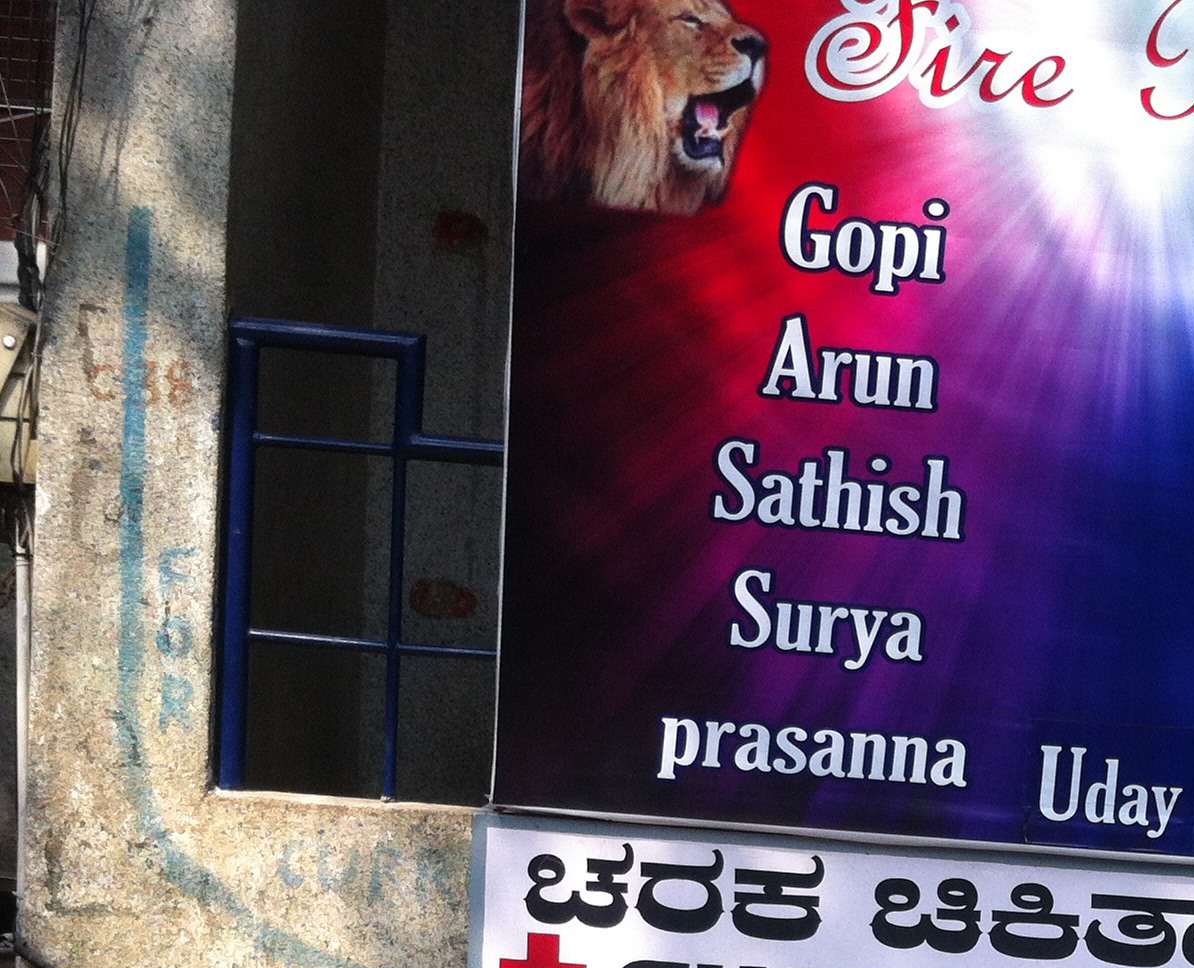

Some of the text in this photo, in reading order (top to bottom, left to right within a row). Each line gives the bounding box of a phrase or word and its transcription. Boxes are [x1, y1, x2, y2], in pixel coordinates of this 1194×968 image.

[814, 0, 1075, 108] Fire
[784, 184, 951, 292] Gopi
[761, 316, 935, 410] Arun
[714, 440, 963, 540] Sathish
[730, 569, 923, 670] Surya
[656, 716, 967, 788] prasanna
[1039, 745, 1183, 838] Uday
[523, 842, 825, 942] ಚರಕ
